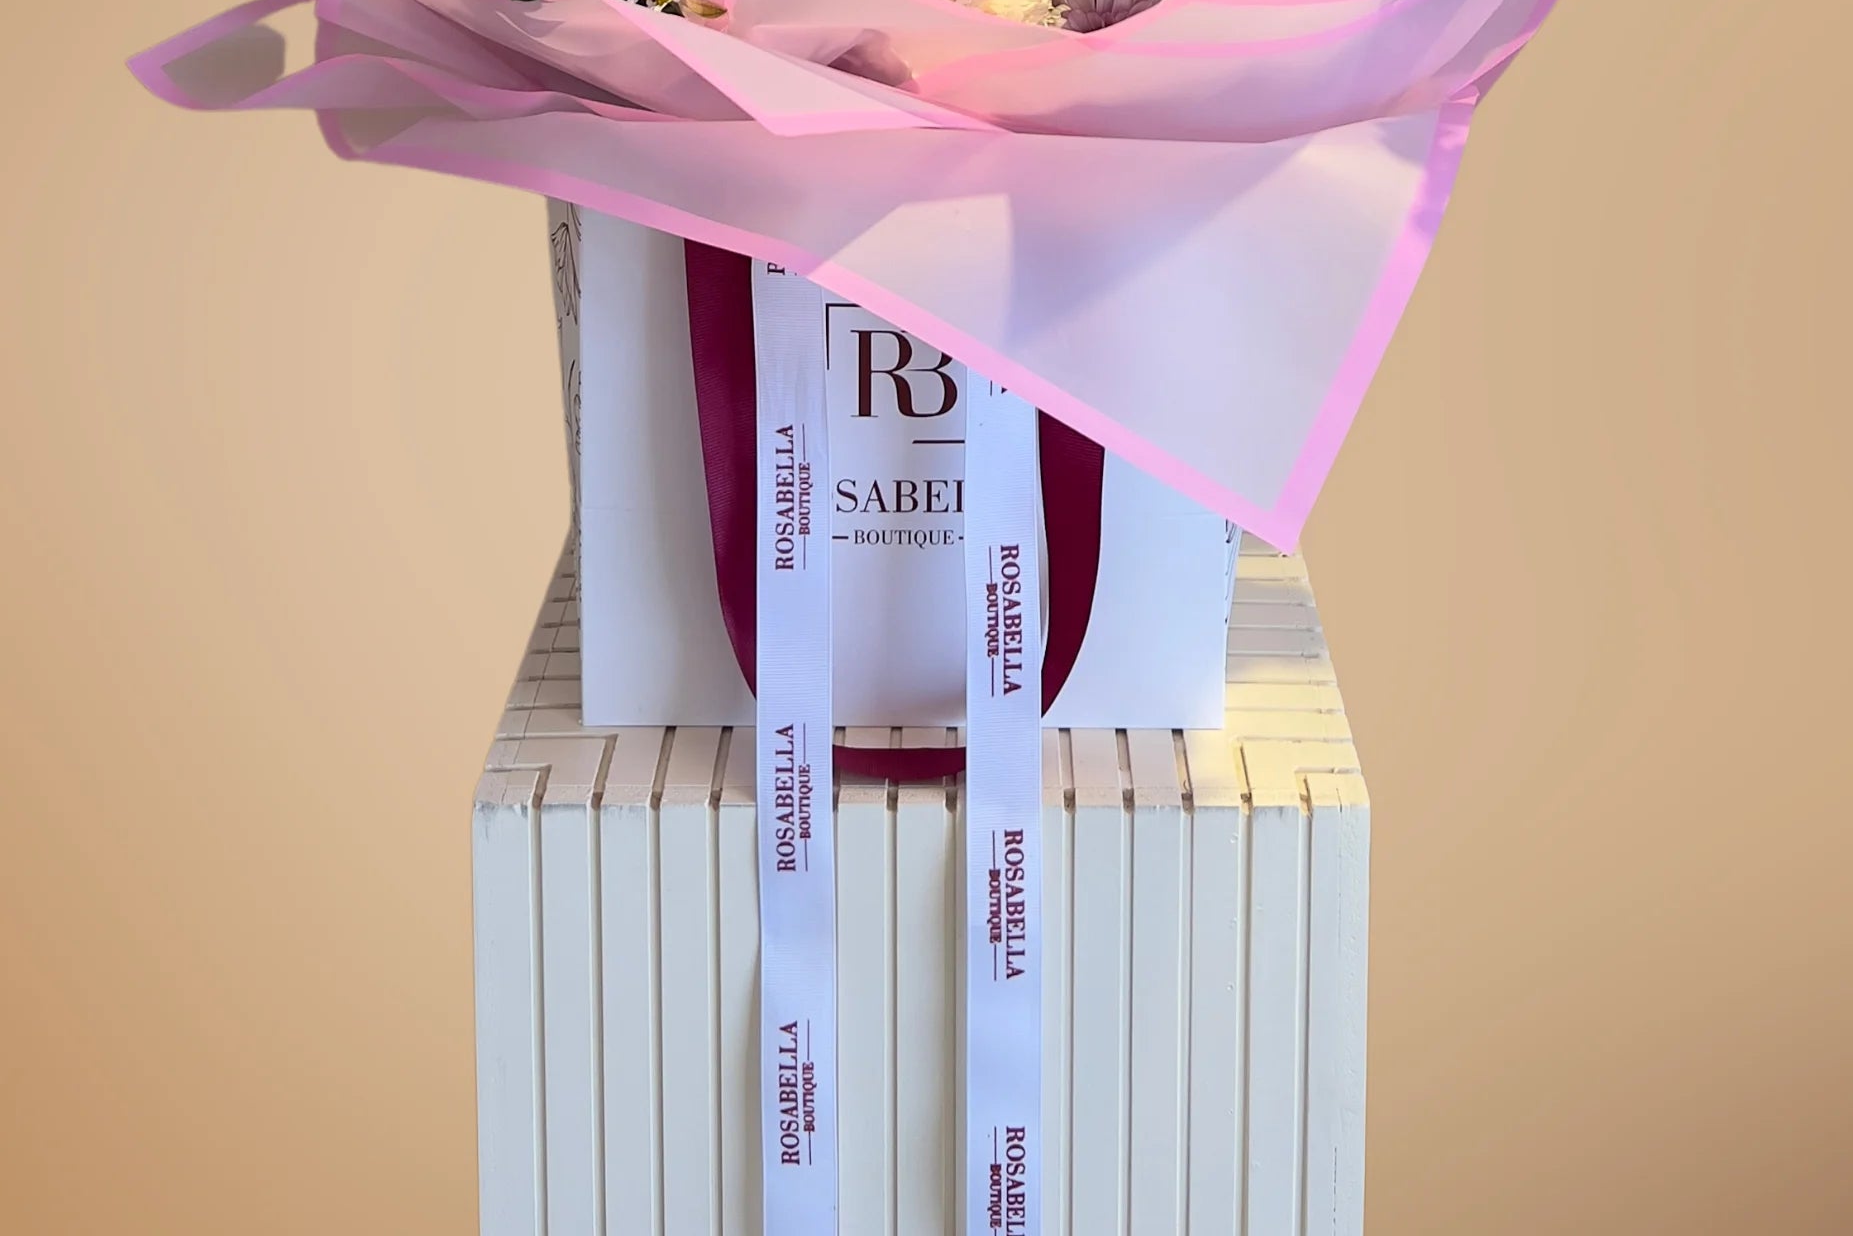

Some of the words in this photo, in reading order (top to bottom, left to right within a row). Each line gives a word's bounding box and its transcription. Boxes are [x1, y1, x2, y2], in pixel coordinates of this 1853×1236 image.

[775, 424, 795, 571] ROSABELLA
[799, 462, 814, 535] BOUTIQUE
[854, 529, 955, 549] BOUTIQUE
[984, 582, 999, 658] BOUTIQUE
[1000, 544, 1022, 696] ROSABELLA
[775, 723, 796, 872] ROSABELLA
[799, 763, 813, 839] BOUTIQUE
[986, 869, 1001, 944] BOUTIQUE
[1003, 829, 1025, 980] ROSABELLA
[779, 1020, 800, 1166] ROSABELLA
[803, 1061, 817, 1133] BOUTIQUE
[987, 1163, 1002, 1228] BOUTIQUE
[1006, 1126, 1026, 1236] ROSABEL
